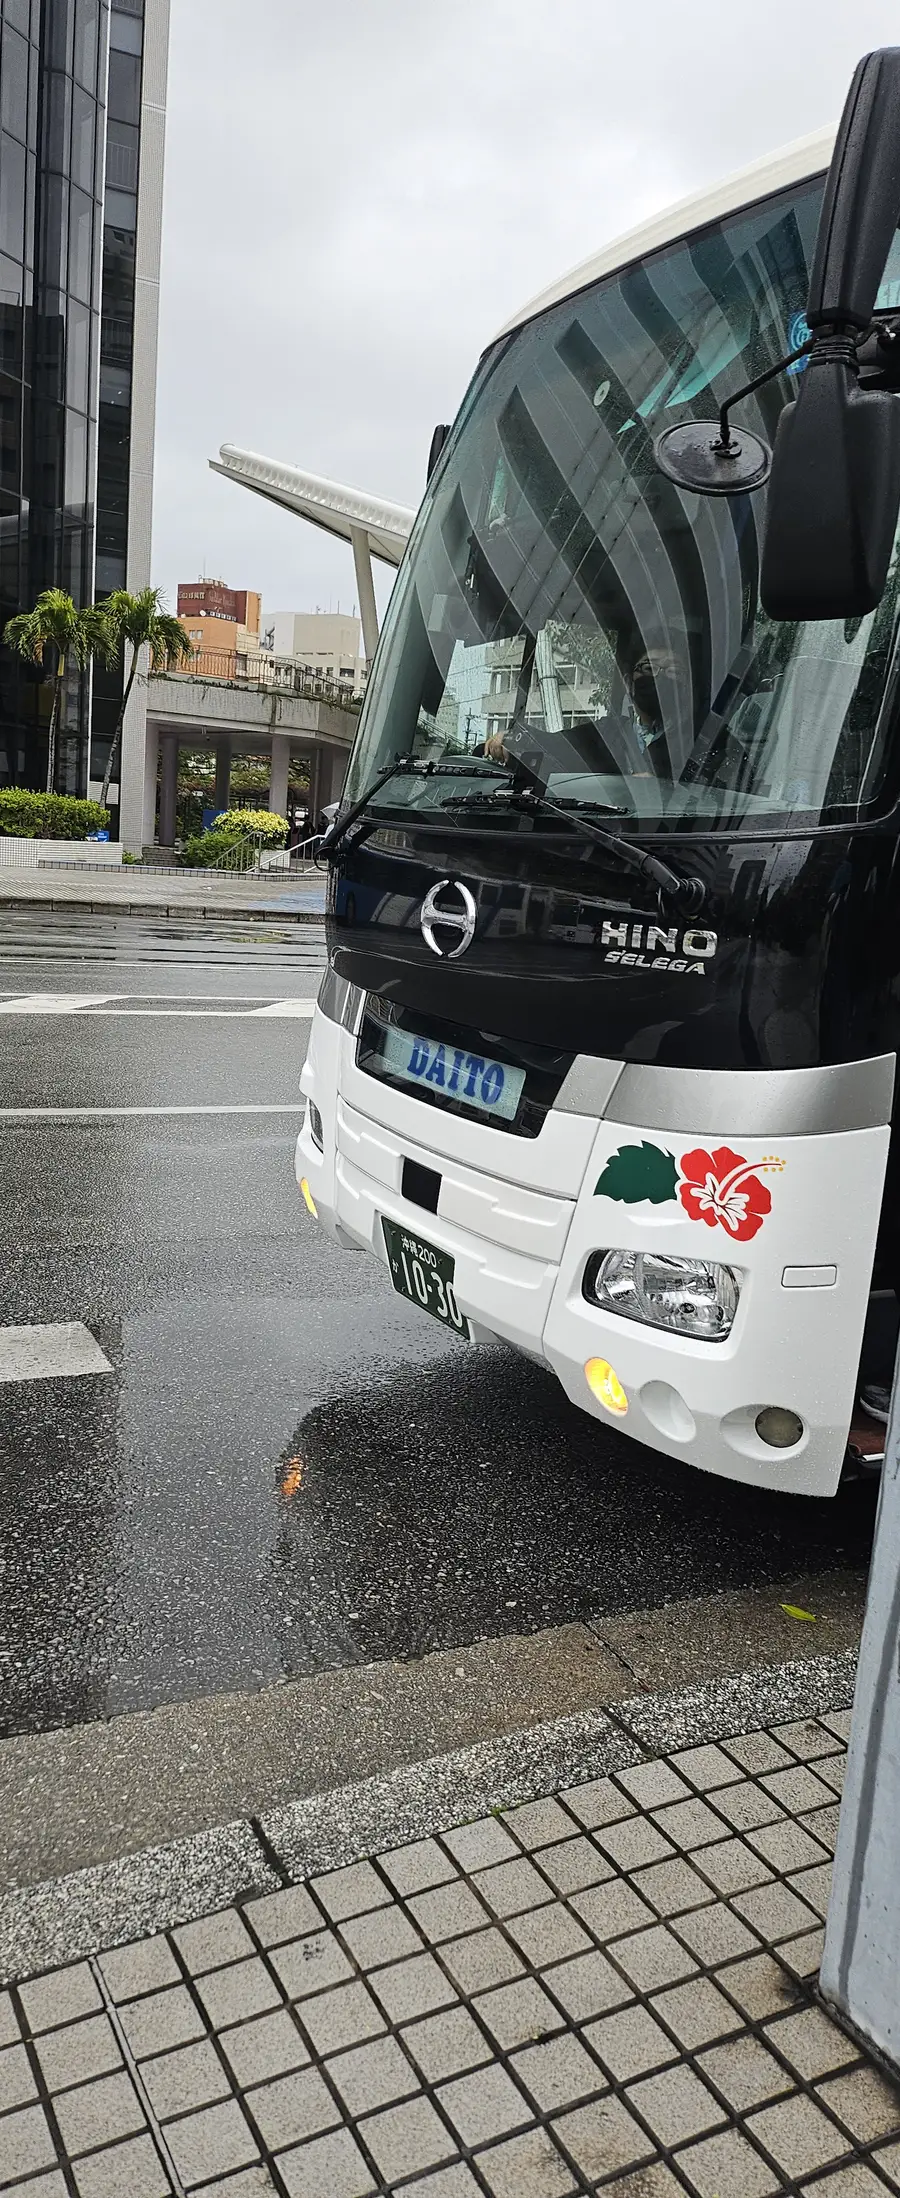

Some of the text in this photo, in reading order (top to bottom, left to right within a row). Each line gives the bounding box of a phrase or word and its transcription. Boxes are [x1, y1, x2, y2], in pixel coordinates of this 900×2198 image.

[601, 921, 718, 958] HINO
[407, 1037, 505, 1105] DAITO
[400, 1251, 463, 1328] 10-30
